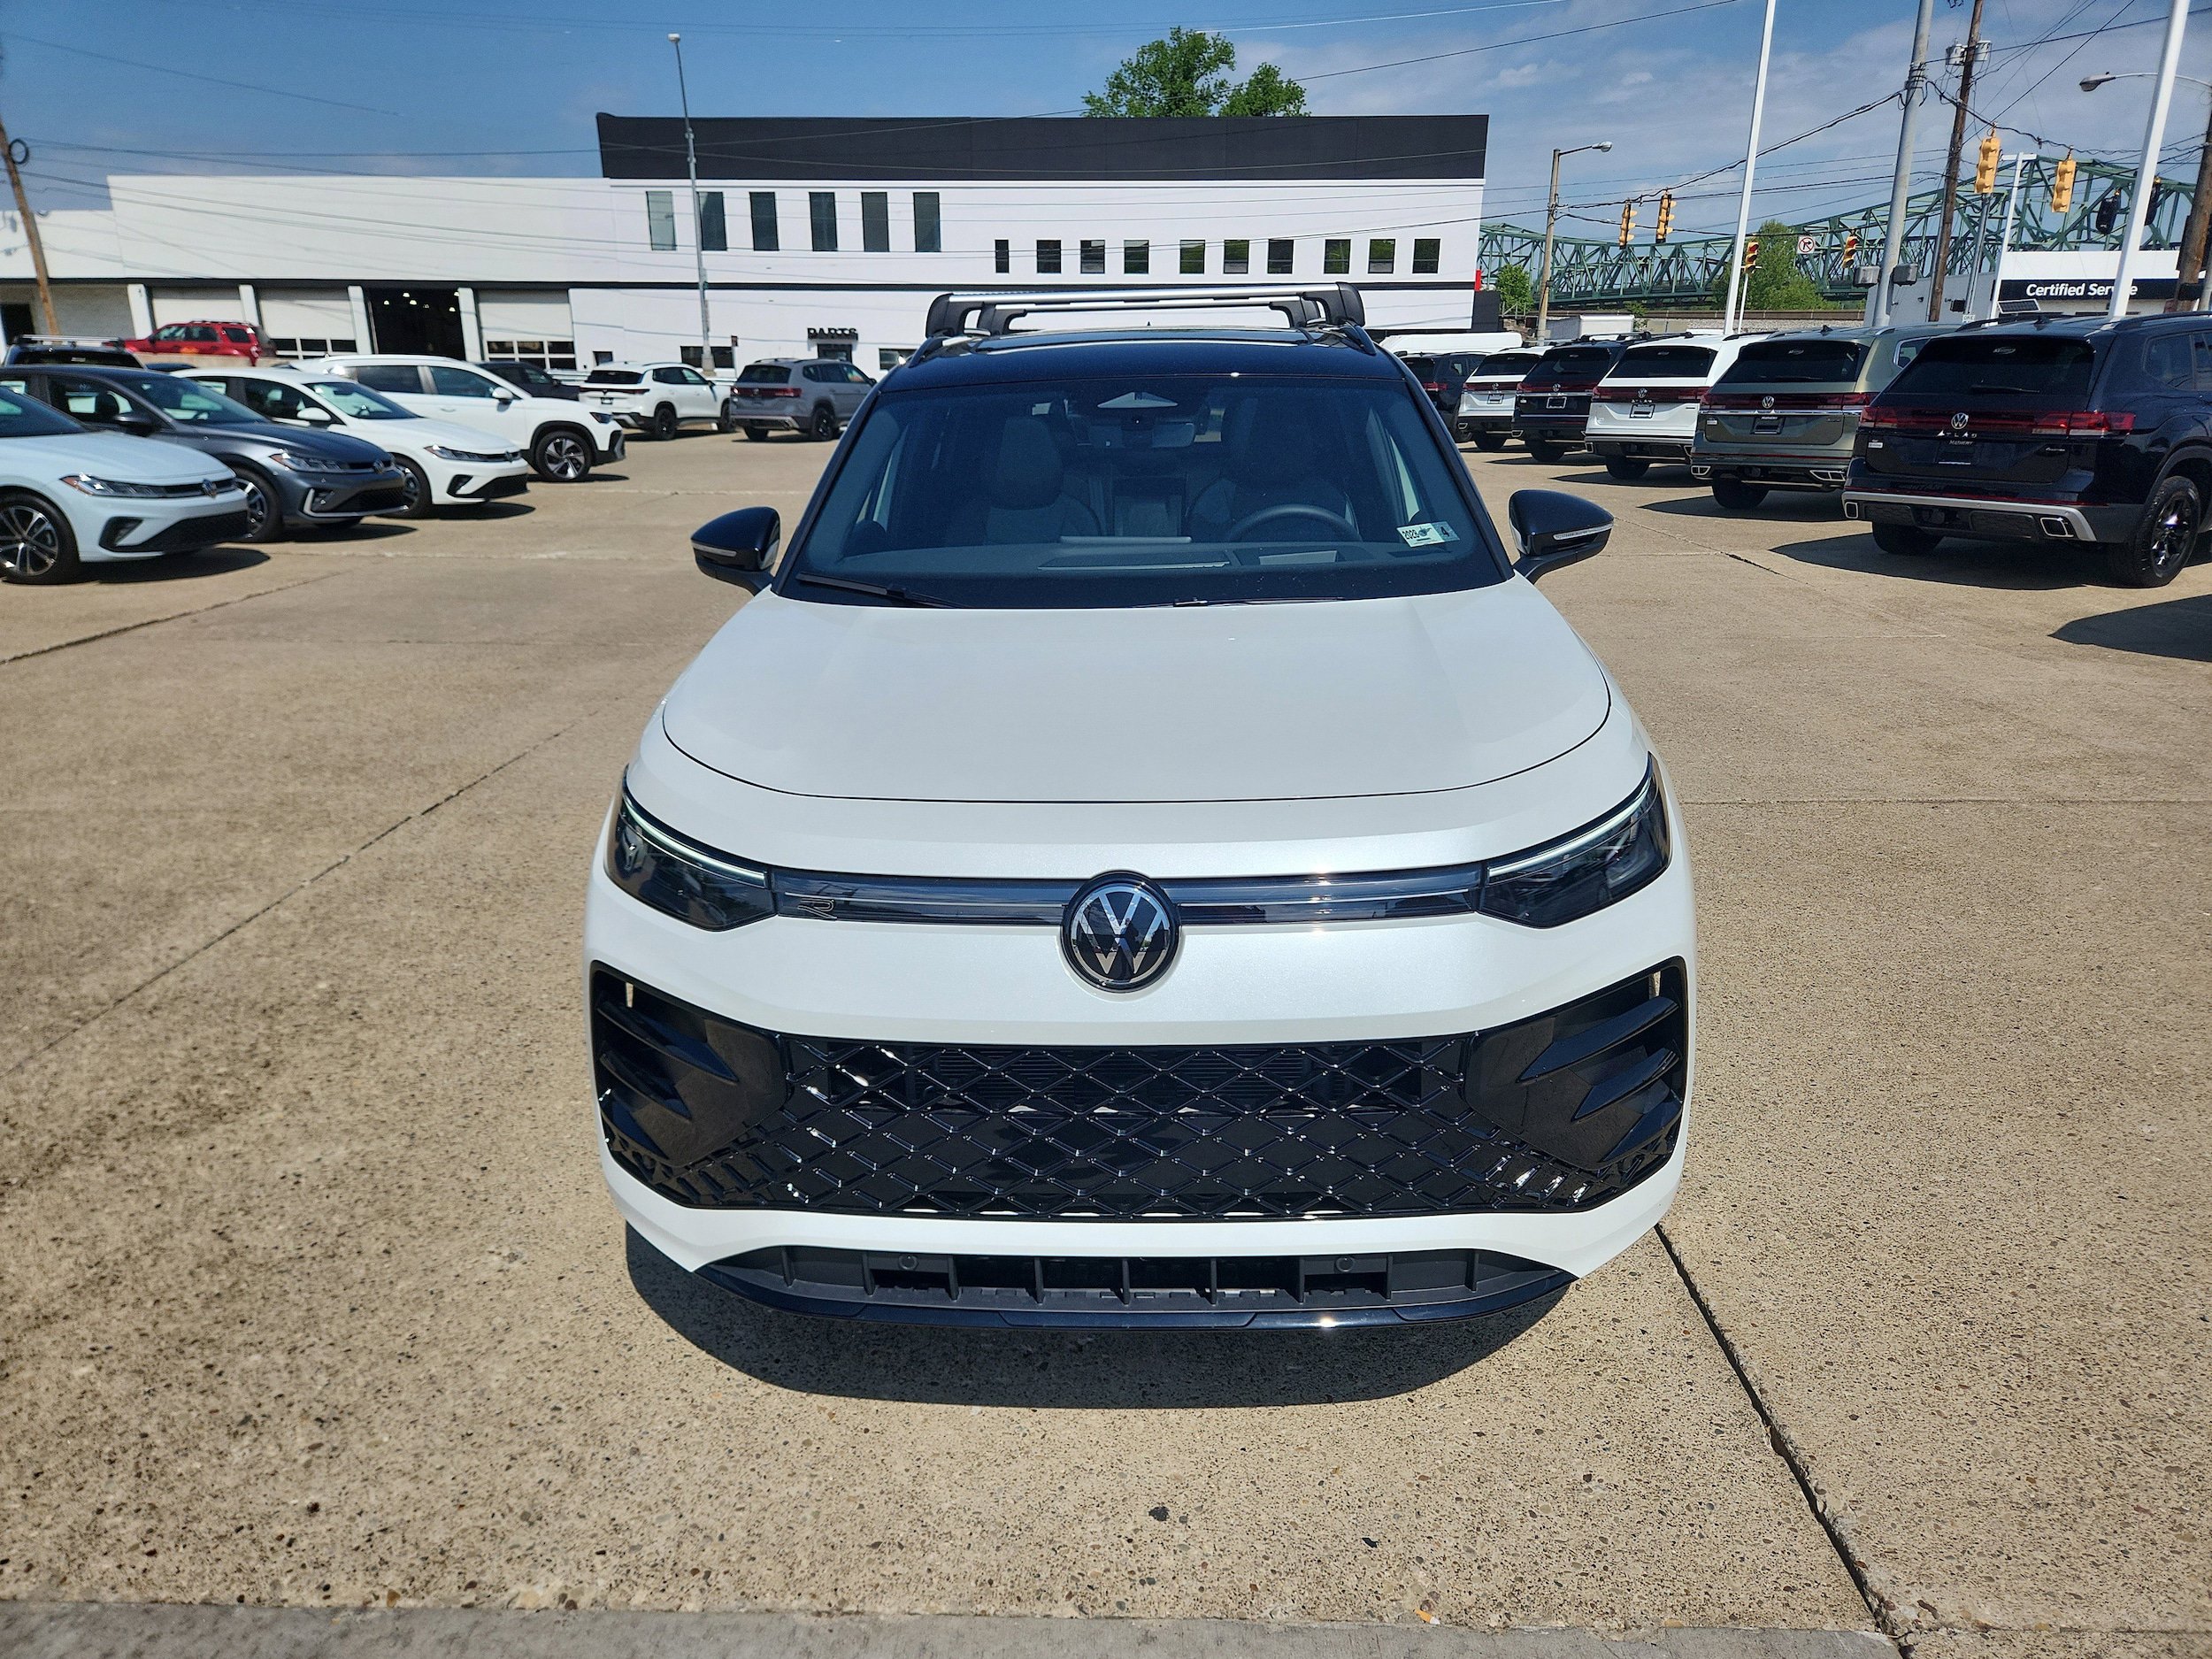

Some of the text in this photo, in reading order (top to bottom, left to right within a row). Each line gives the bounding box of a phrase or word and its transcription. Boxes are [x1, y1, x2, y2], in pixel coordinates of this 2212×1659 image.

[2026, 283, 2085, 296] Certified
[807, 327, 858, 341] PARTS
[1440, 526, 1450, 537] 4
